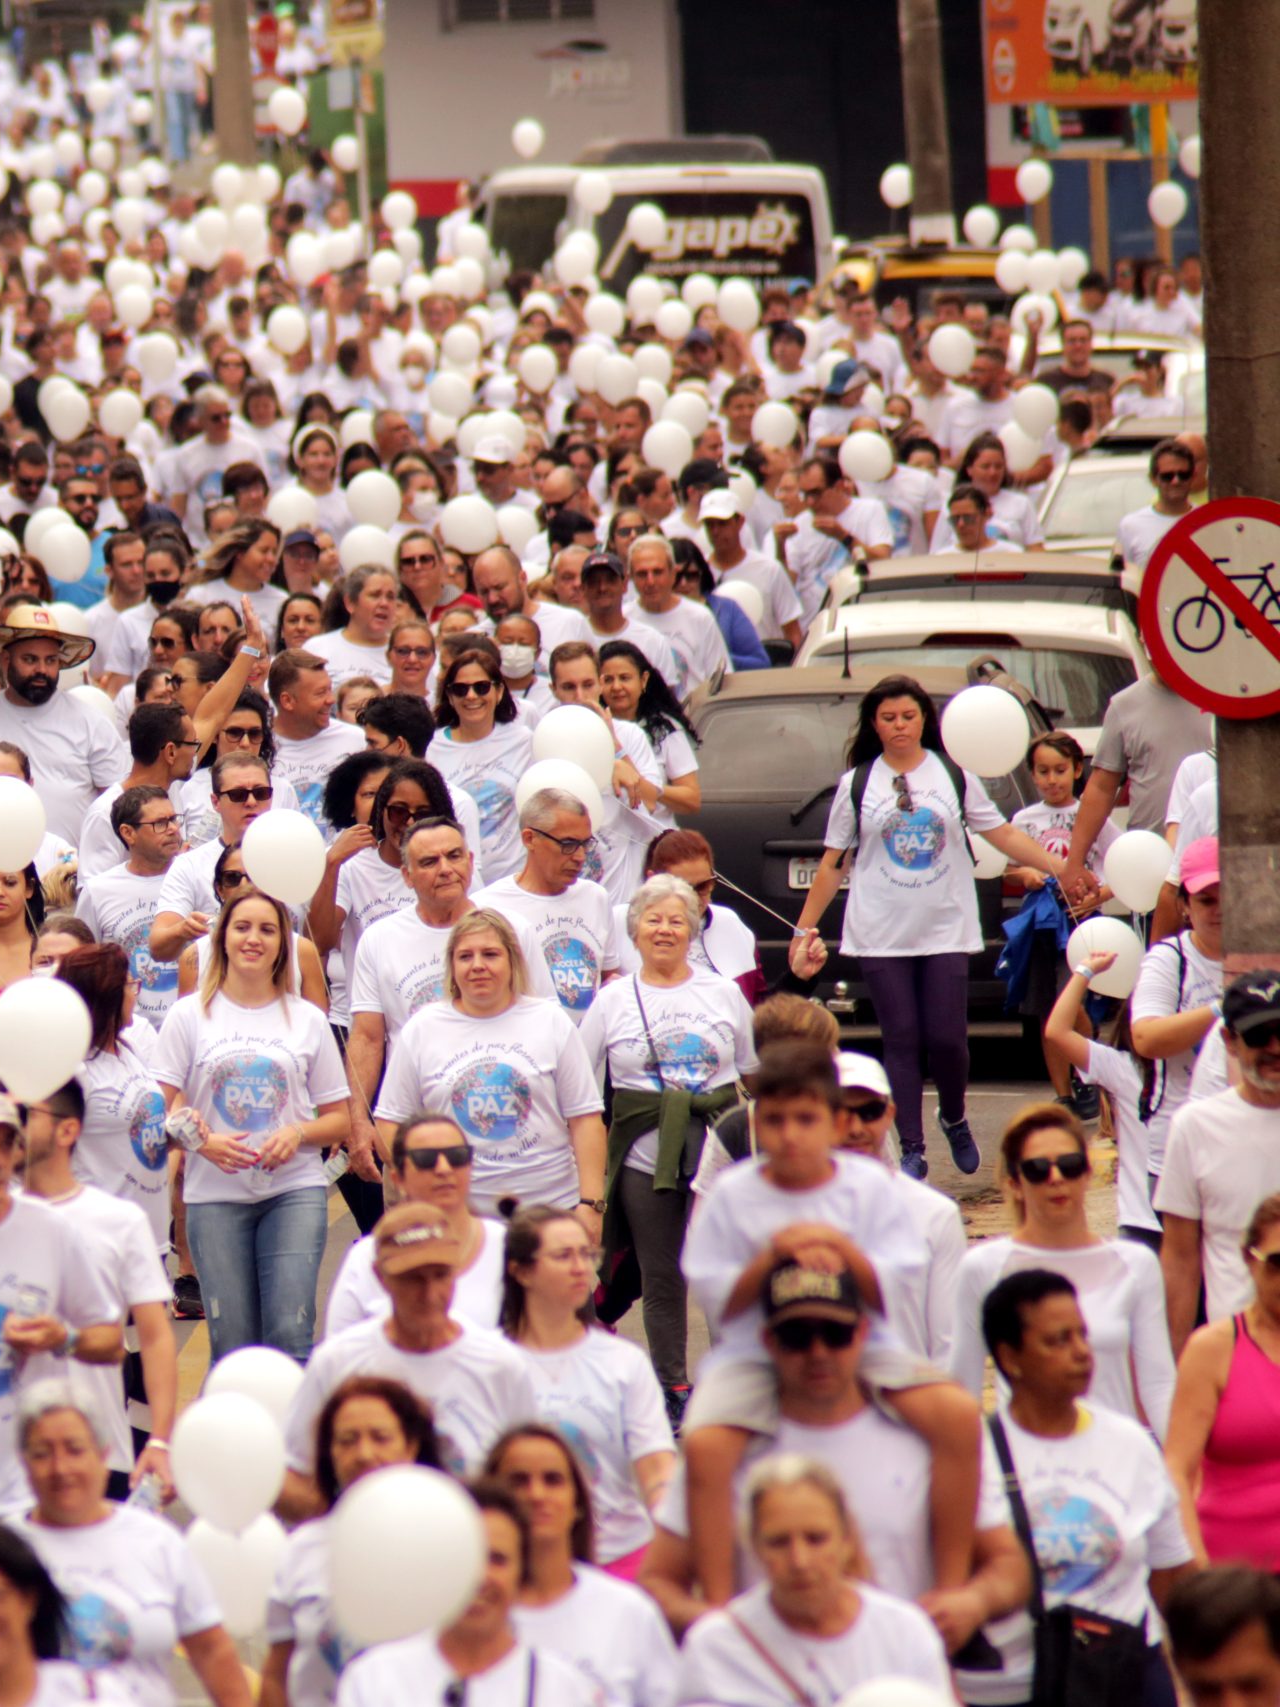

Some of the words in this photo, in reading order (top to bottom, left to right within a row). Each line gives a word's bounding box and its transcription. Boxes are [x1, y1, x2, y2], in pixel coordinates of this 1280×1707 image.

[894, 832, 936, 851] PAZ
[136, 896, 146, 911] de
[545, 912, 556, 927] de
[557, 916, 574, 929] paz
[429, 952, 442, 967] de
[552, 967, 594, 989] PAZ
[231, 1031, 244, 1042] de
[247, 1035, 266, 1046] paz
[471, 1040, 484, 1053] de
[487, 1043, 506, 1053] paz
[660, 1062, 708, 1080] PAZ
[225, 1085, 275, 1109] PAZ
[467, 1095, 518, 1118] PAZ
